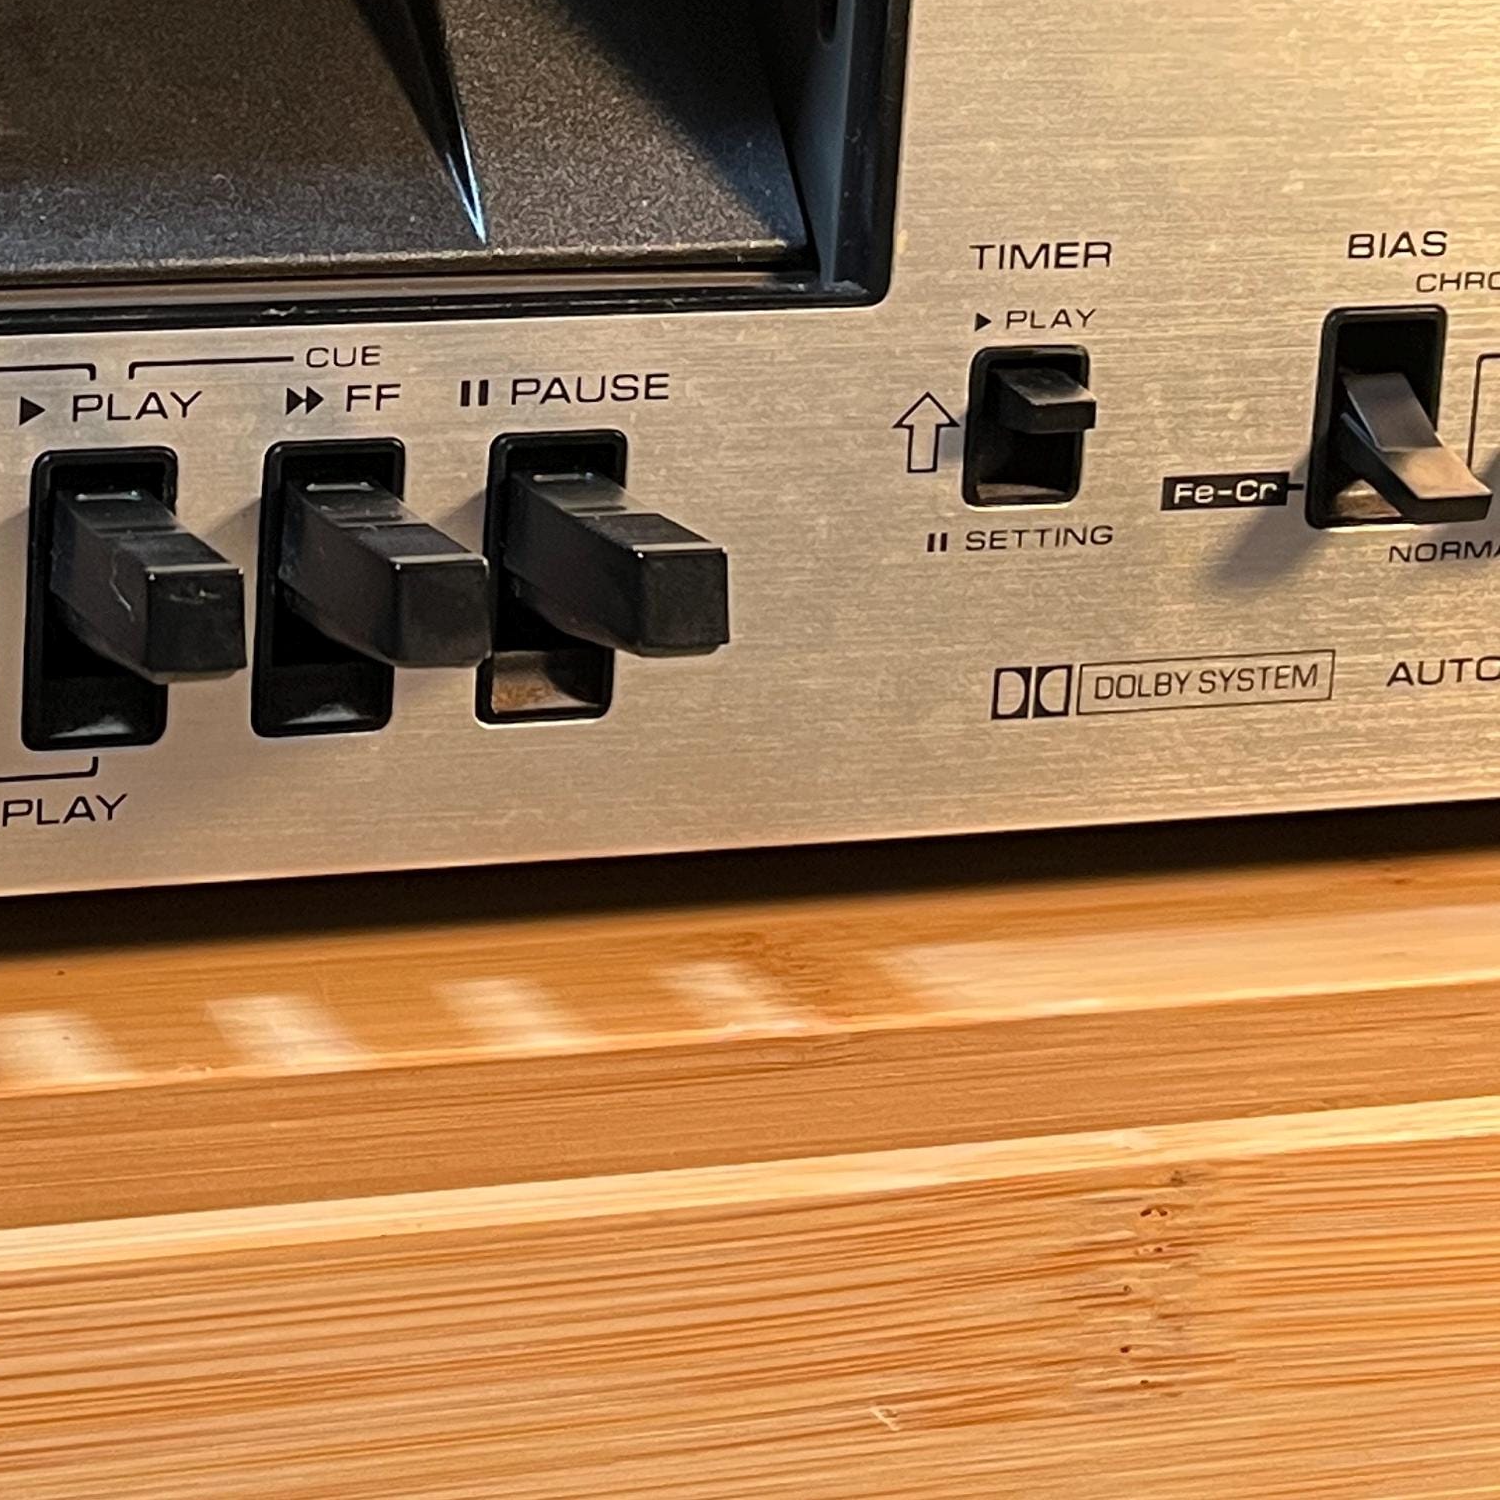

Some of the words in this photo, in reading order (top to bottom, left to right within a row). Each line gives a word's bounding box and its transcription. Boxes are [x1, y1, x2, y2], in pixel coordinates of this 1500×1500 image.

[969, 241, 1112, 270] TIMER
[1348, 230, 1448, 259] BIAS
[1006, 308, 1096, 330] PLAY
[306, 345, 381, 368] CUE
[346, 383, 401, 413] FF
[511, 373, 670, 406] PAUSE
[72, 390, 202, 423] PLAY
[1173, 478, 1279, 505] Fe-Cr
[965, 525, 1113, 551] SETTING
[1389, 540, 1500, 563] NORM
[1094, 671, 1191, 700] DOLBY
[1196, 657, 1318, 694] SYSTEM
[1386, 655, 1500, 687] AUTO
[2, 793, 128, 827] PLAY
